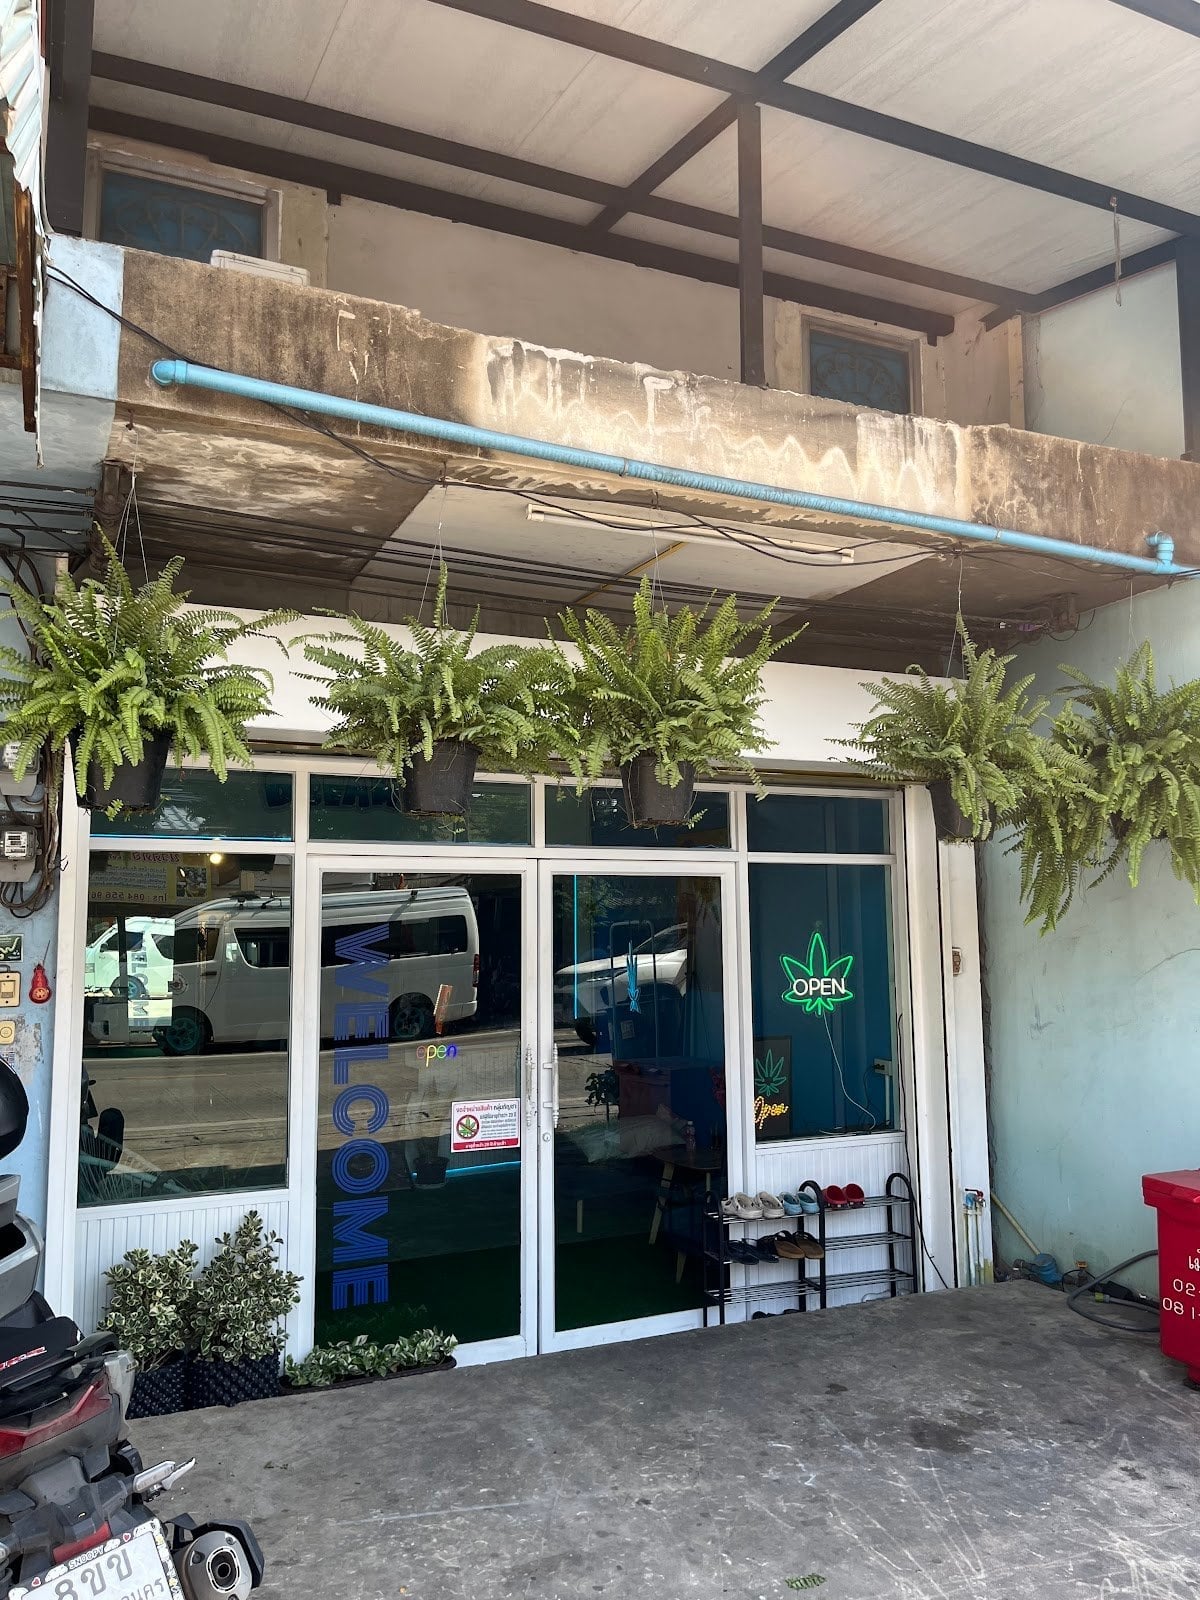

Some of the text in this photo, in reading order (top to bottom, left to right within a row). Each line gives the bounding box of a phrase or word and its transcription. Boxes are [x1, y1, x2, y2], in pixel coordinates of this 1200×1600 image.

[793, 978, 846, 996] OPEN
[416, 1044, 458, 1068] open
[332, 922, 390, 1310] WELCOME
[68, 1545, 105, 1570] SNOOPY
